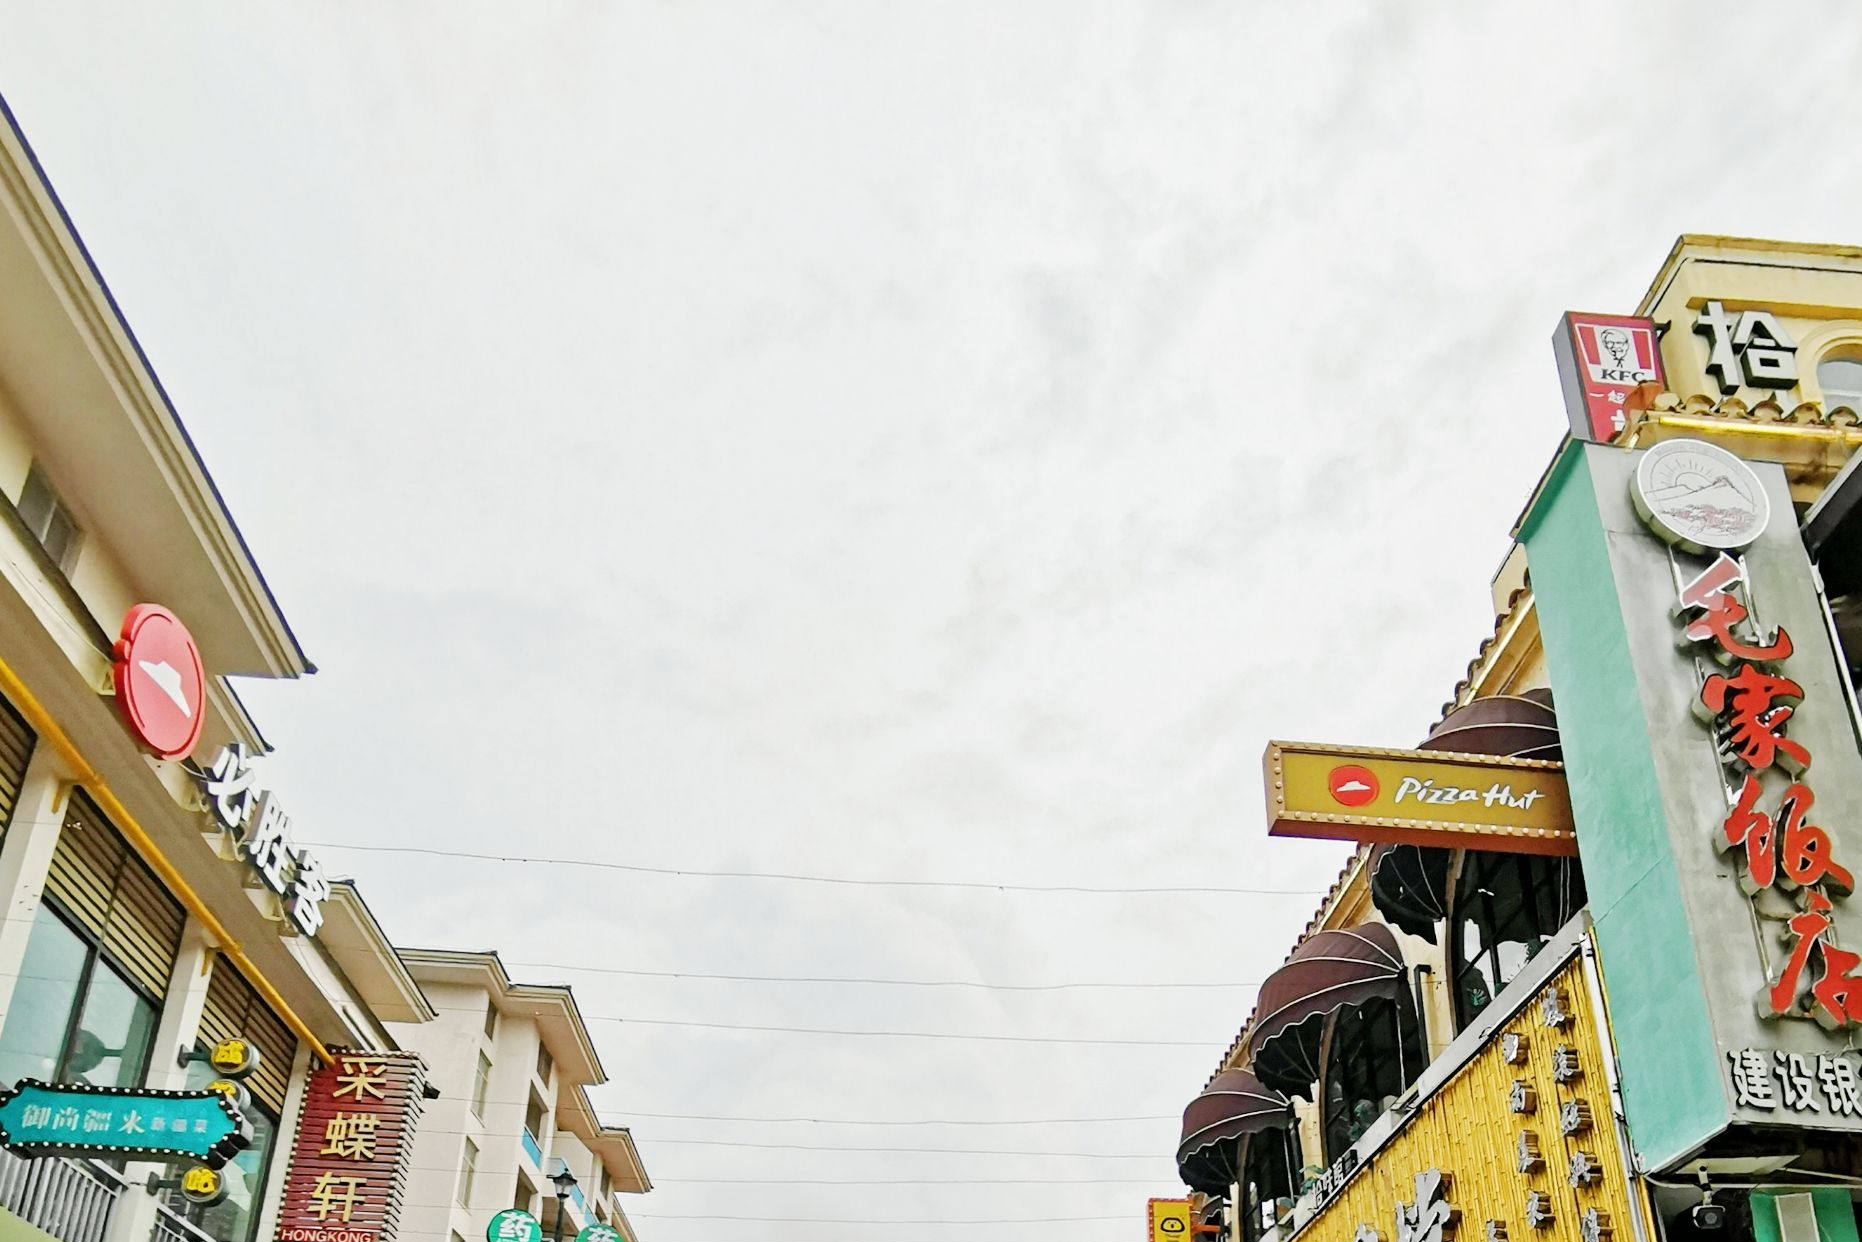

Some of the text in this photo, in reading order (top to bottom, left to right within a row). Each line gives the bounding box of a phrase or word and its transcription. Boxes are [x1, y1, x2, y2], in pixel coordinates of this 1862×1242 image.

[1601, 369, 1647, 382] KFC
[204, 743, 331, 937] 必胜客
[1395, 776, 1546, 810] Pizza Hut
[306, 1057, 387, 1224] 采蝶轩
